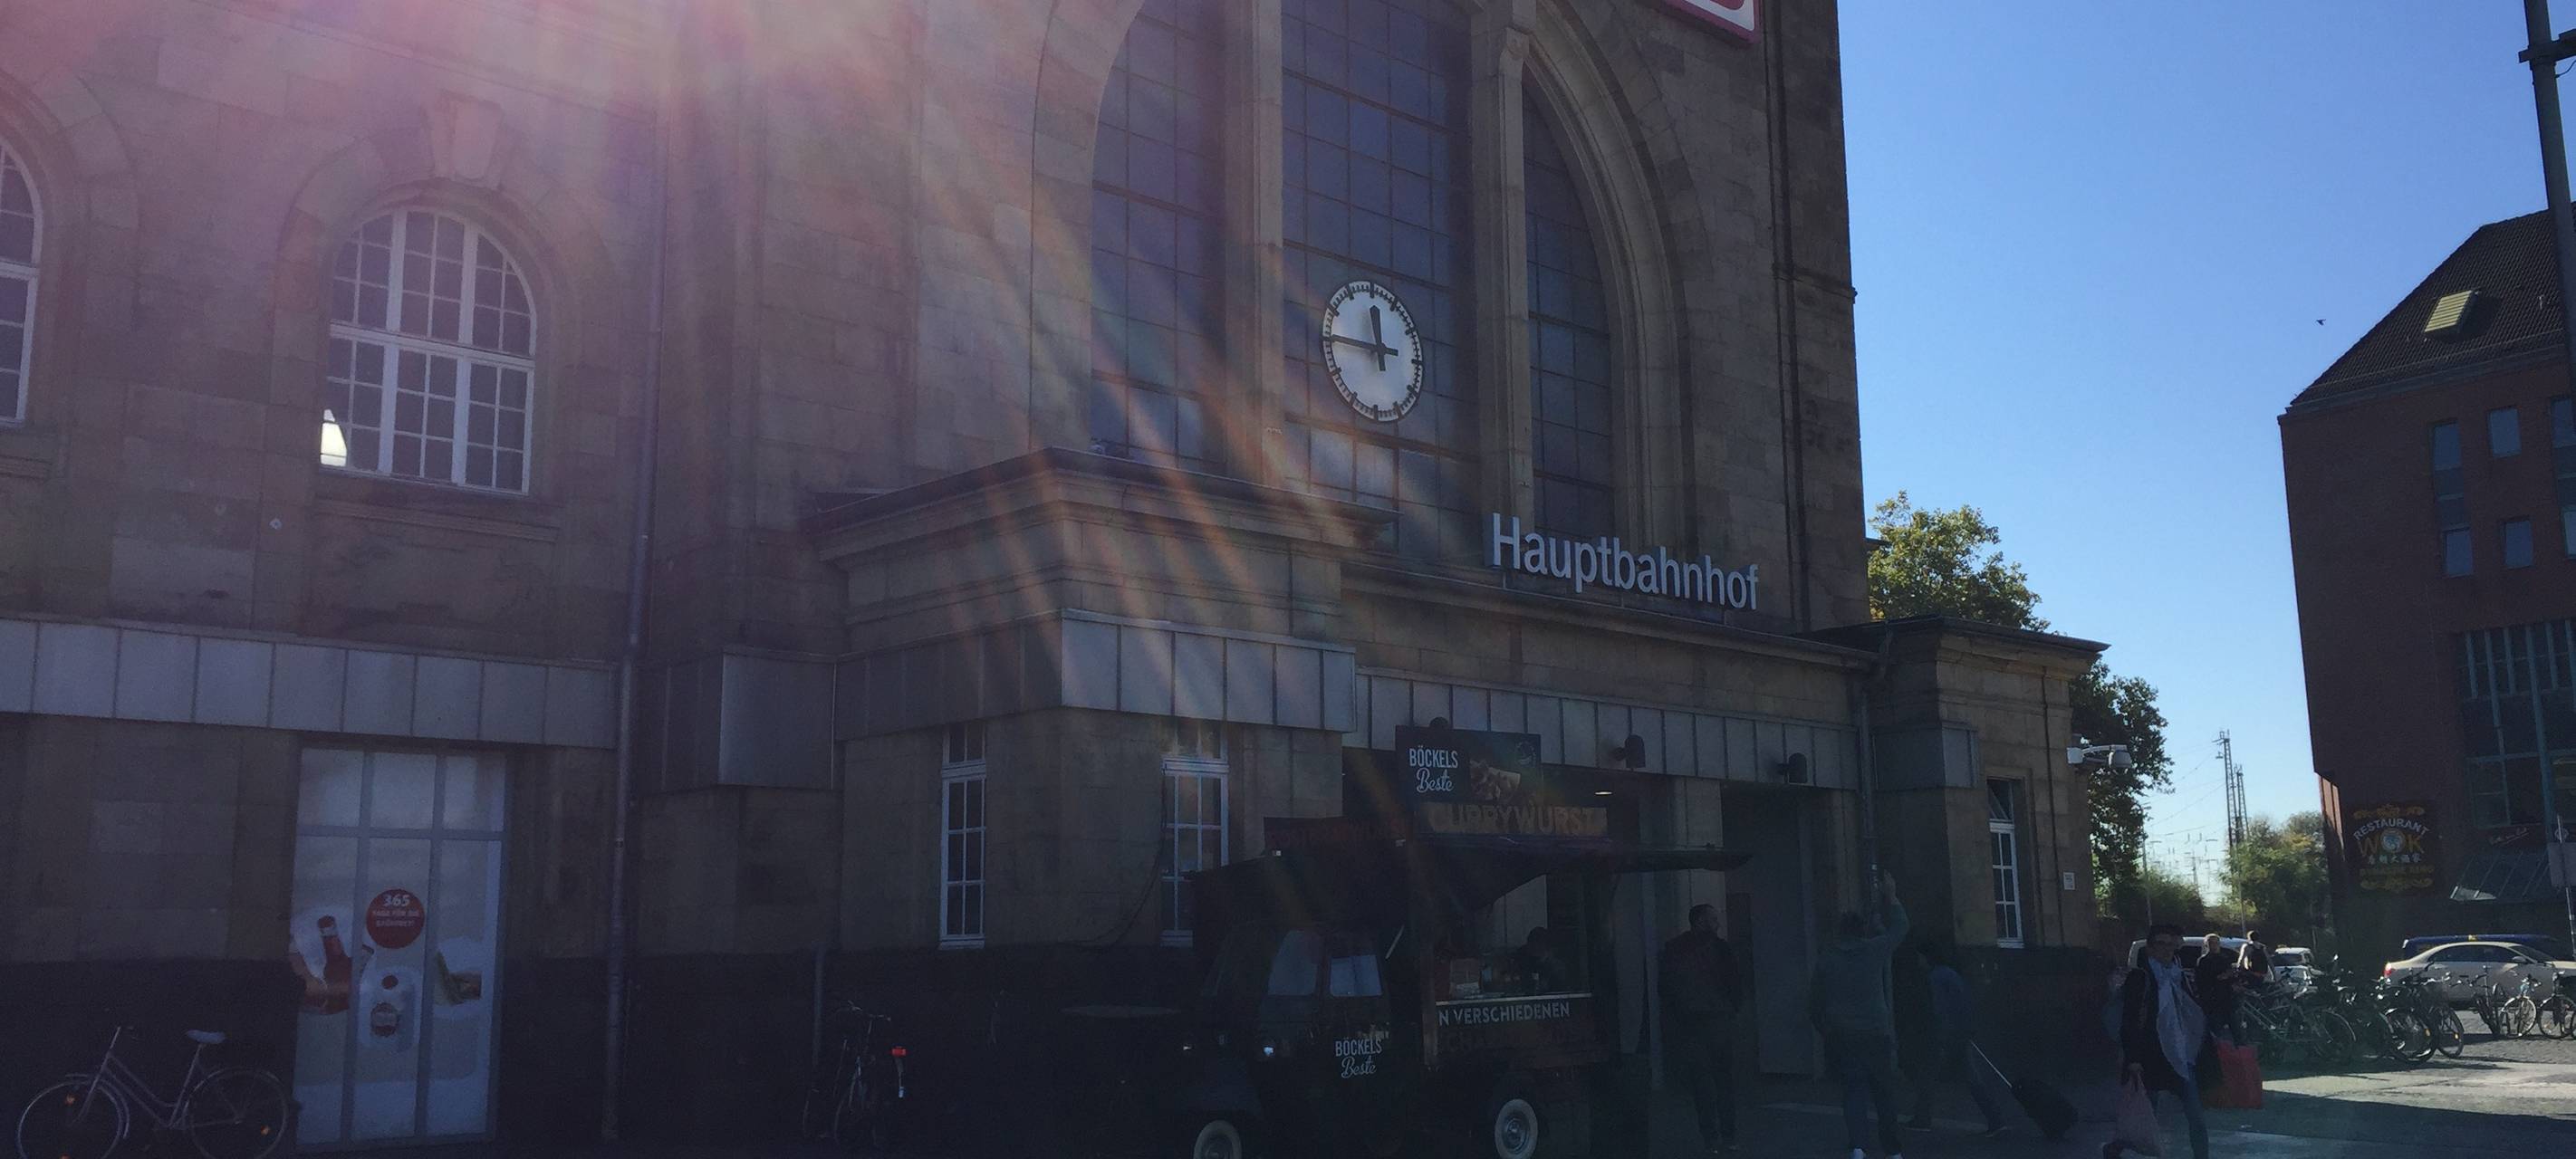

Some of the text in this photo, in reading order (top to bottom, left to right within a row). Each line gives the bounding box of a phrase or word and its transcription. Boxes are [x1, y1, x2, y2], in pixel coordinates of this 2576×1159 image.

[1490, 512, 1759, 609] Hauptbahnhof
[1408, 745, 1458, 768] BÖCKELS
[1416, 768, 1455, 793] Beste
[2353, 818, 2430, 841] RESTAURANT
[383, 894, 410, 907] 365
[1453, 1001, 1571, 1024] VERSCHIEDENEN
[1335, 1037, 1382, 1057] BÖCKELS
[1341, 1056, 1377, 1078] Beste
